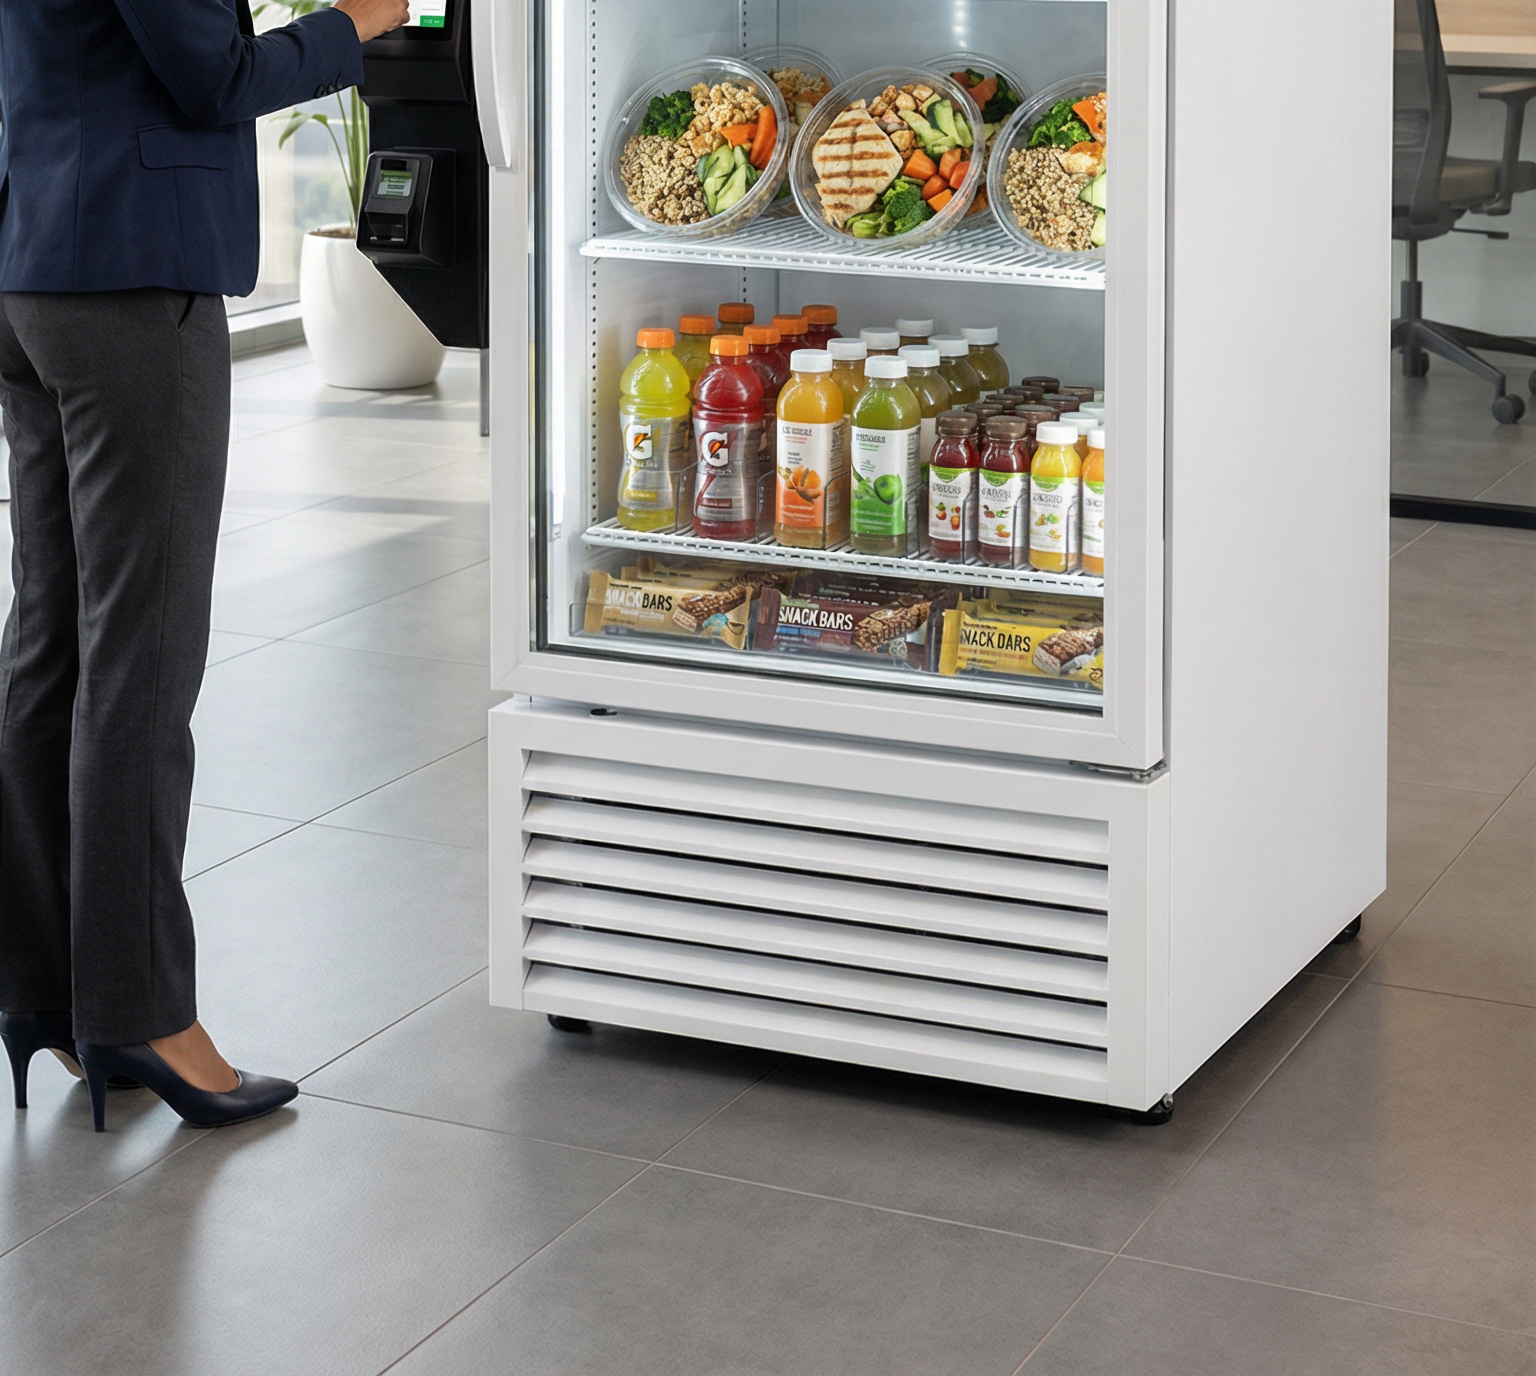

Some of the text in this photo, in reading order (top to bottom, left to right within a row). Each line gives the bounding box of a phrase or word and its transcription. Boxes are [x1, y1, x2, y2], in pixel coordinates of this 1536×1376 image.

[626, 424, 653, 460] G
[701, 431, 729, 467] G
[641, 592, 673, 612] BARS
[778, 605, 854, 631] SNACK BARS
